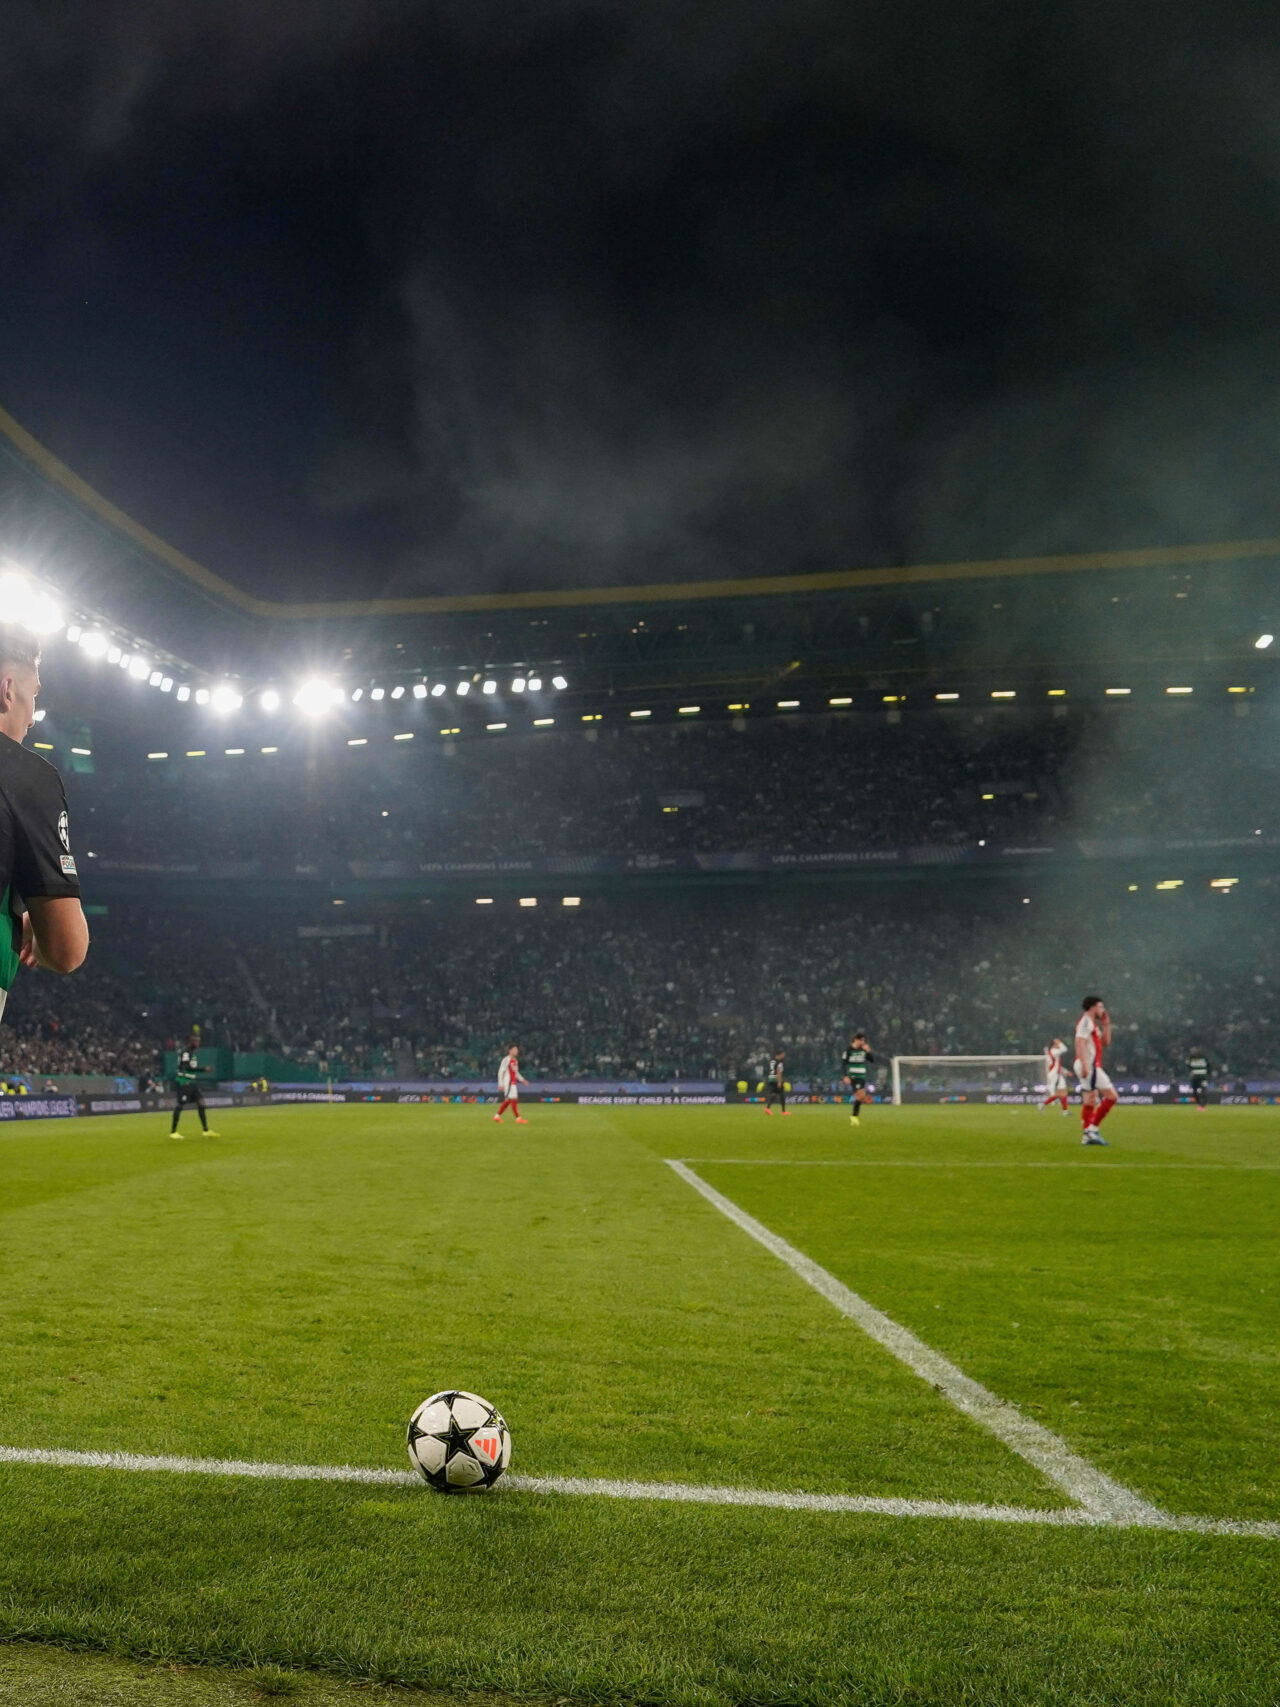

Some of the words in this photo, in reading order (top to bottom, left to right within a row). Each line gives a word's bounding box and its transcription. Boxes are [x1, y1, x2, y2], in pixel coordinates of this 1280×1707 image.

[578, 1096, 613, 1104] BECAUSE
[613, 1096, 638, 1104] EVERY
[639, 1096, 663, 1104] CHILD
[673, 1096, 680, 1104] A
[680, 1096, 726, 1104] CHAMPION
